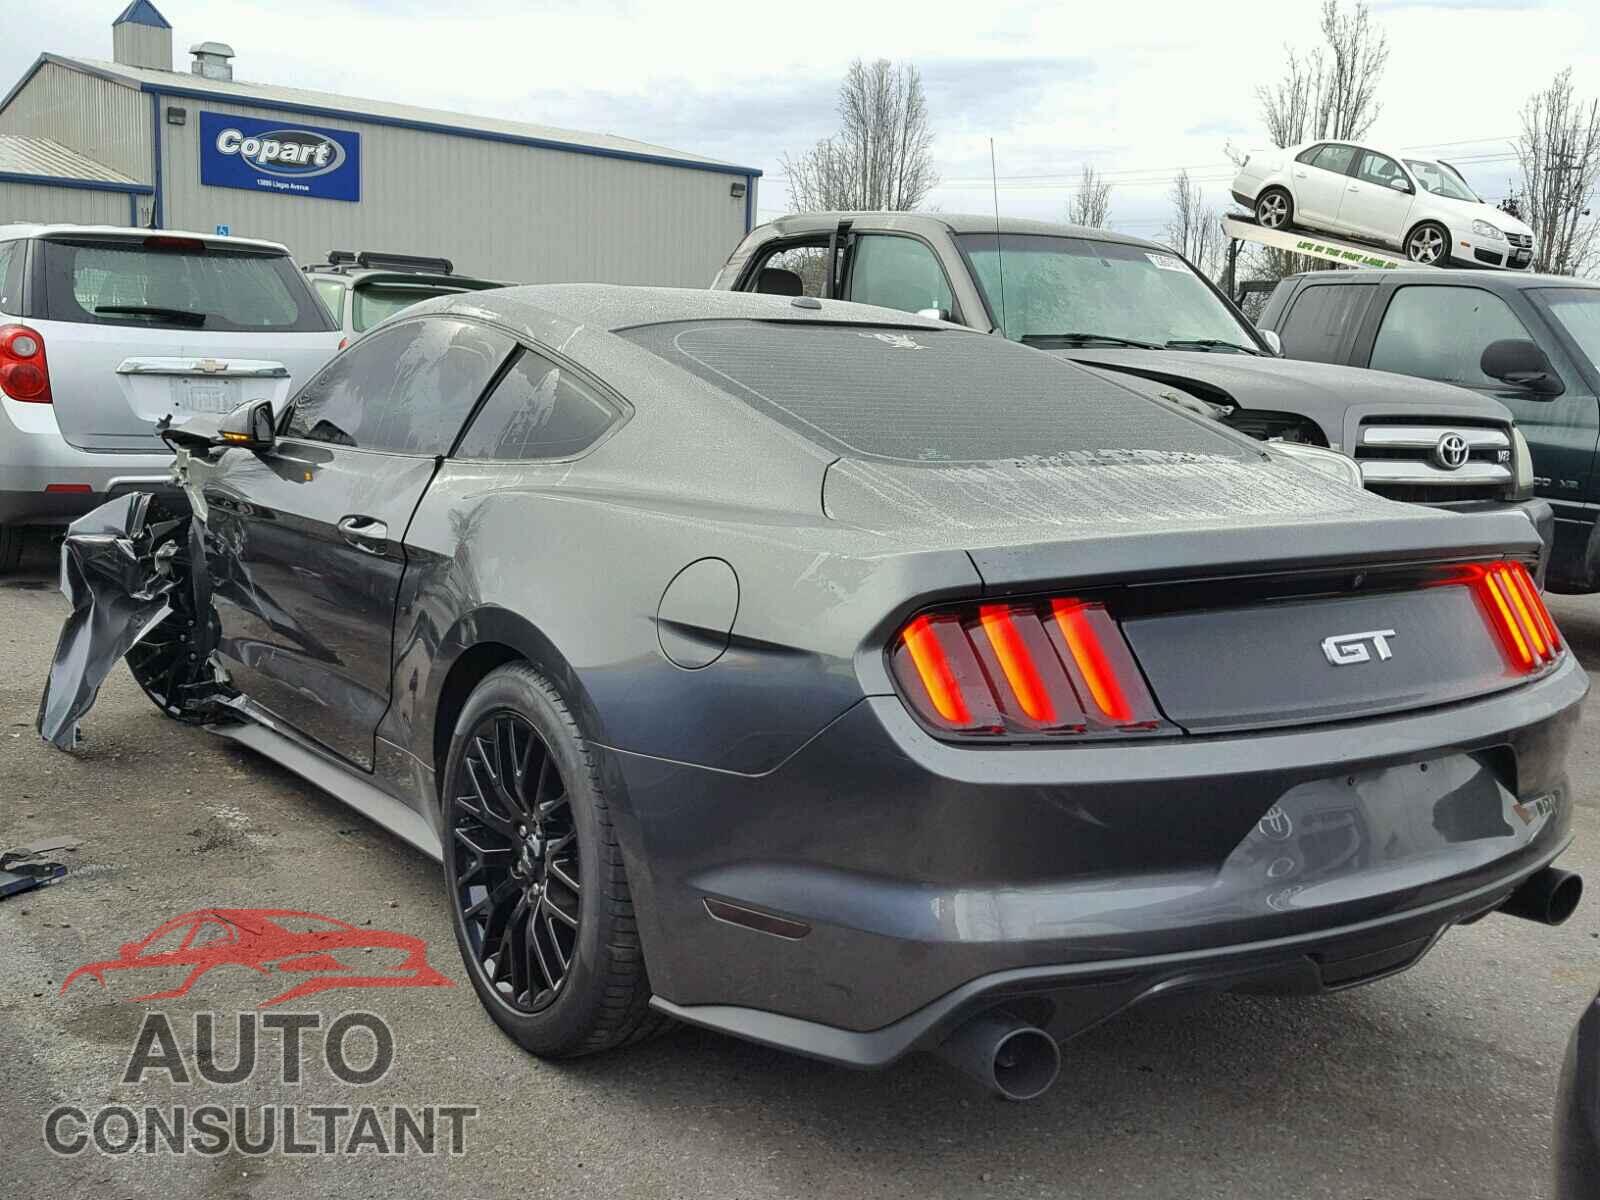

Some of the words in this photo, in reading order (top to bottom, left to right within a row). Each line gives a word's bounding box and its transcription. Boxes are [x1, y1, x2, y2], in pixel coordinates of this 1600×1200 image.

[216, 128, 332, 168] Copart
[290, 182, 310, 192] Avenue
[1297, 241, 1315, 251] LIFE
[1326, 247, 1341, 257] THE
[1320, 628, 1396, 665] GT
